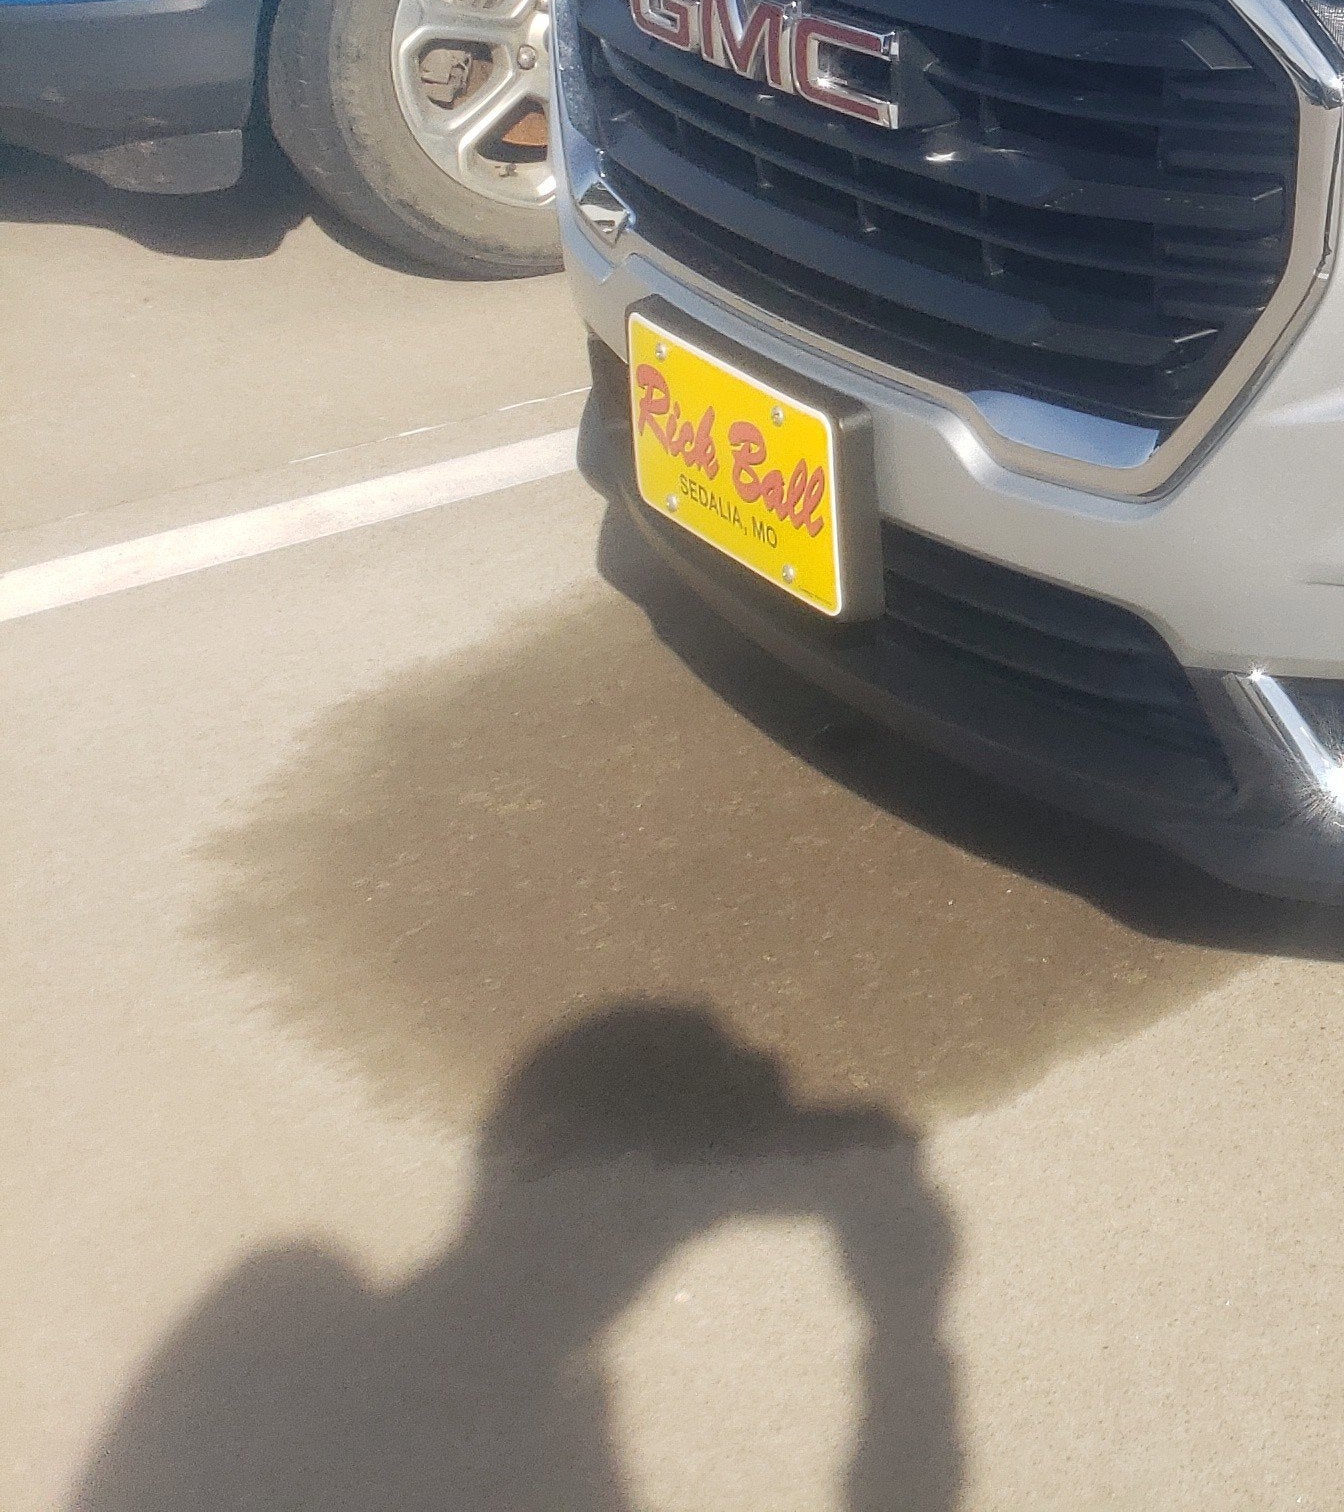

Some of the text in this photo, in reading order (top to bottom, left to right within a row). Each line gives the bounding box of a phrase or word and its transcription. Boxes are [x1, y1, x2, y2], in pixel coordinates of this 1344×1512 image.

[636, 364, 825, 537] Rick Ball
[679, 473, 777, 548] SEDALIA, MO
